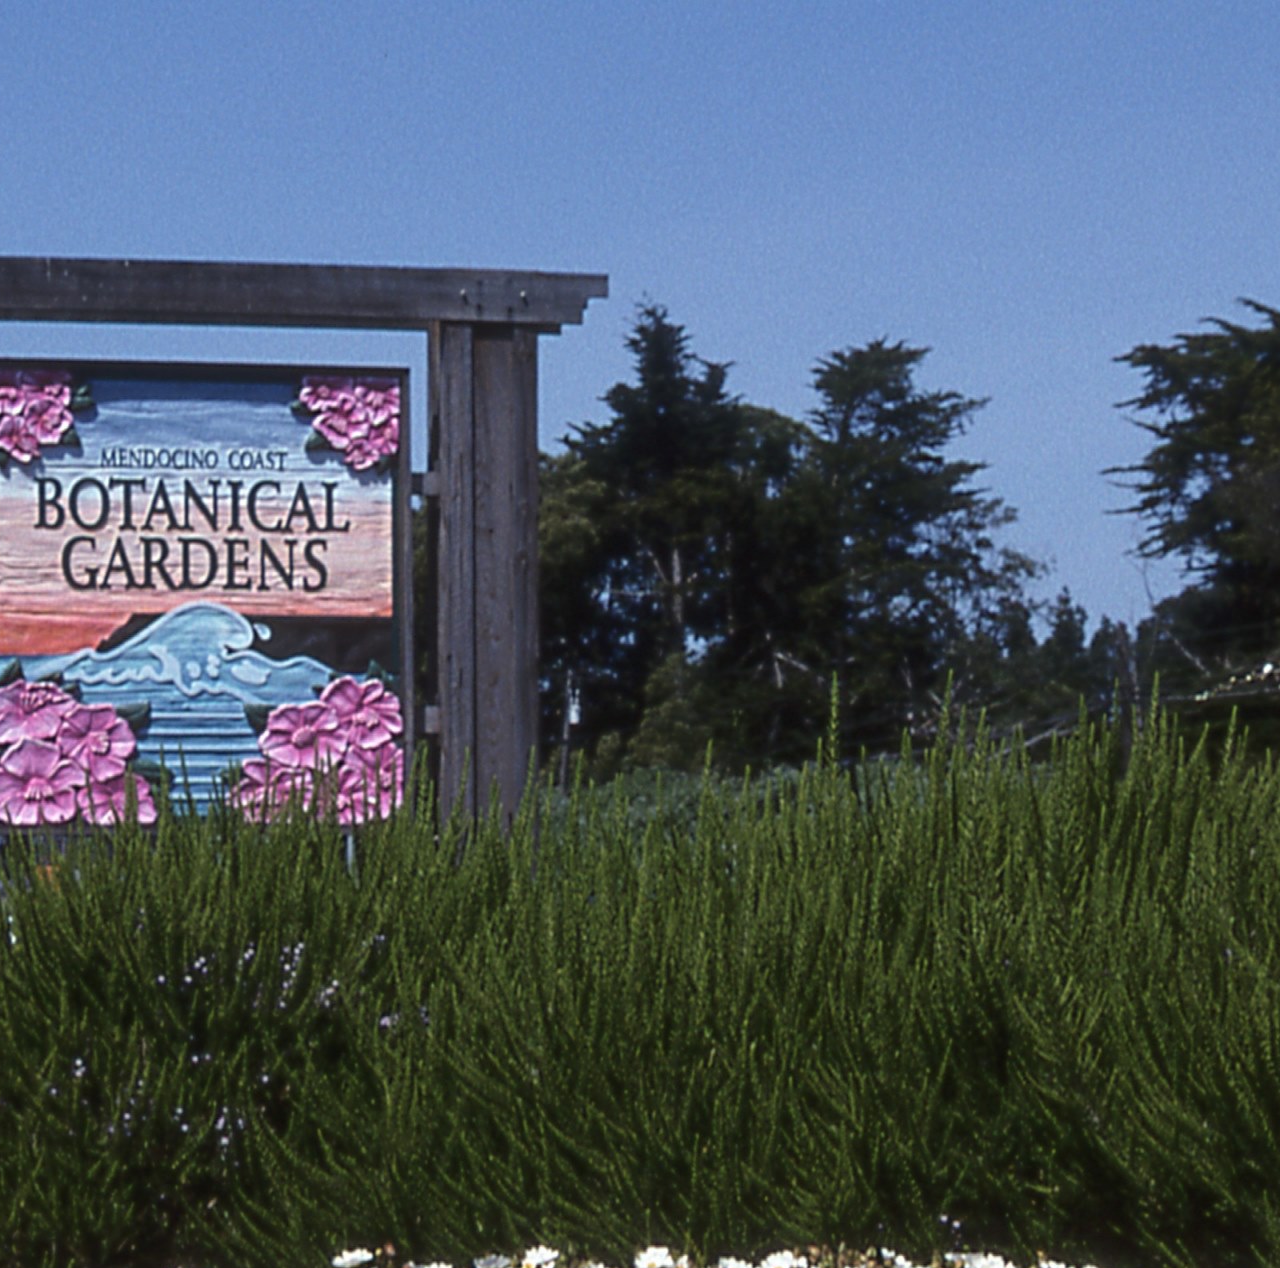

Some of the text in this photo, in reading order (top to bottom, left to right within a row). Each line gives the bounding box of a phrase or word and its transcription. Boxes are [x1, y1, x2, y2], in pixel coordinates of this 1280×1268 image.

[100, 448, 288, 471] MENDOCINO COAST
[34, 476, 350, 533] BOTANICAL
[61, 535, 328, 593] GARDENS
